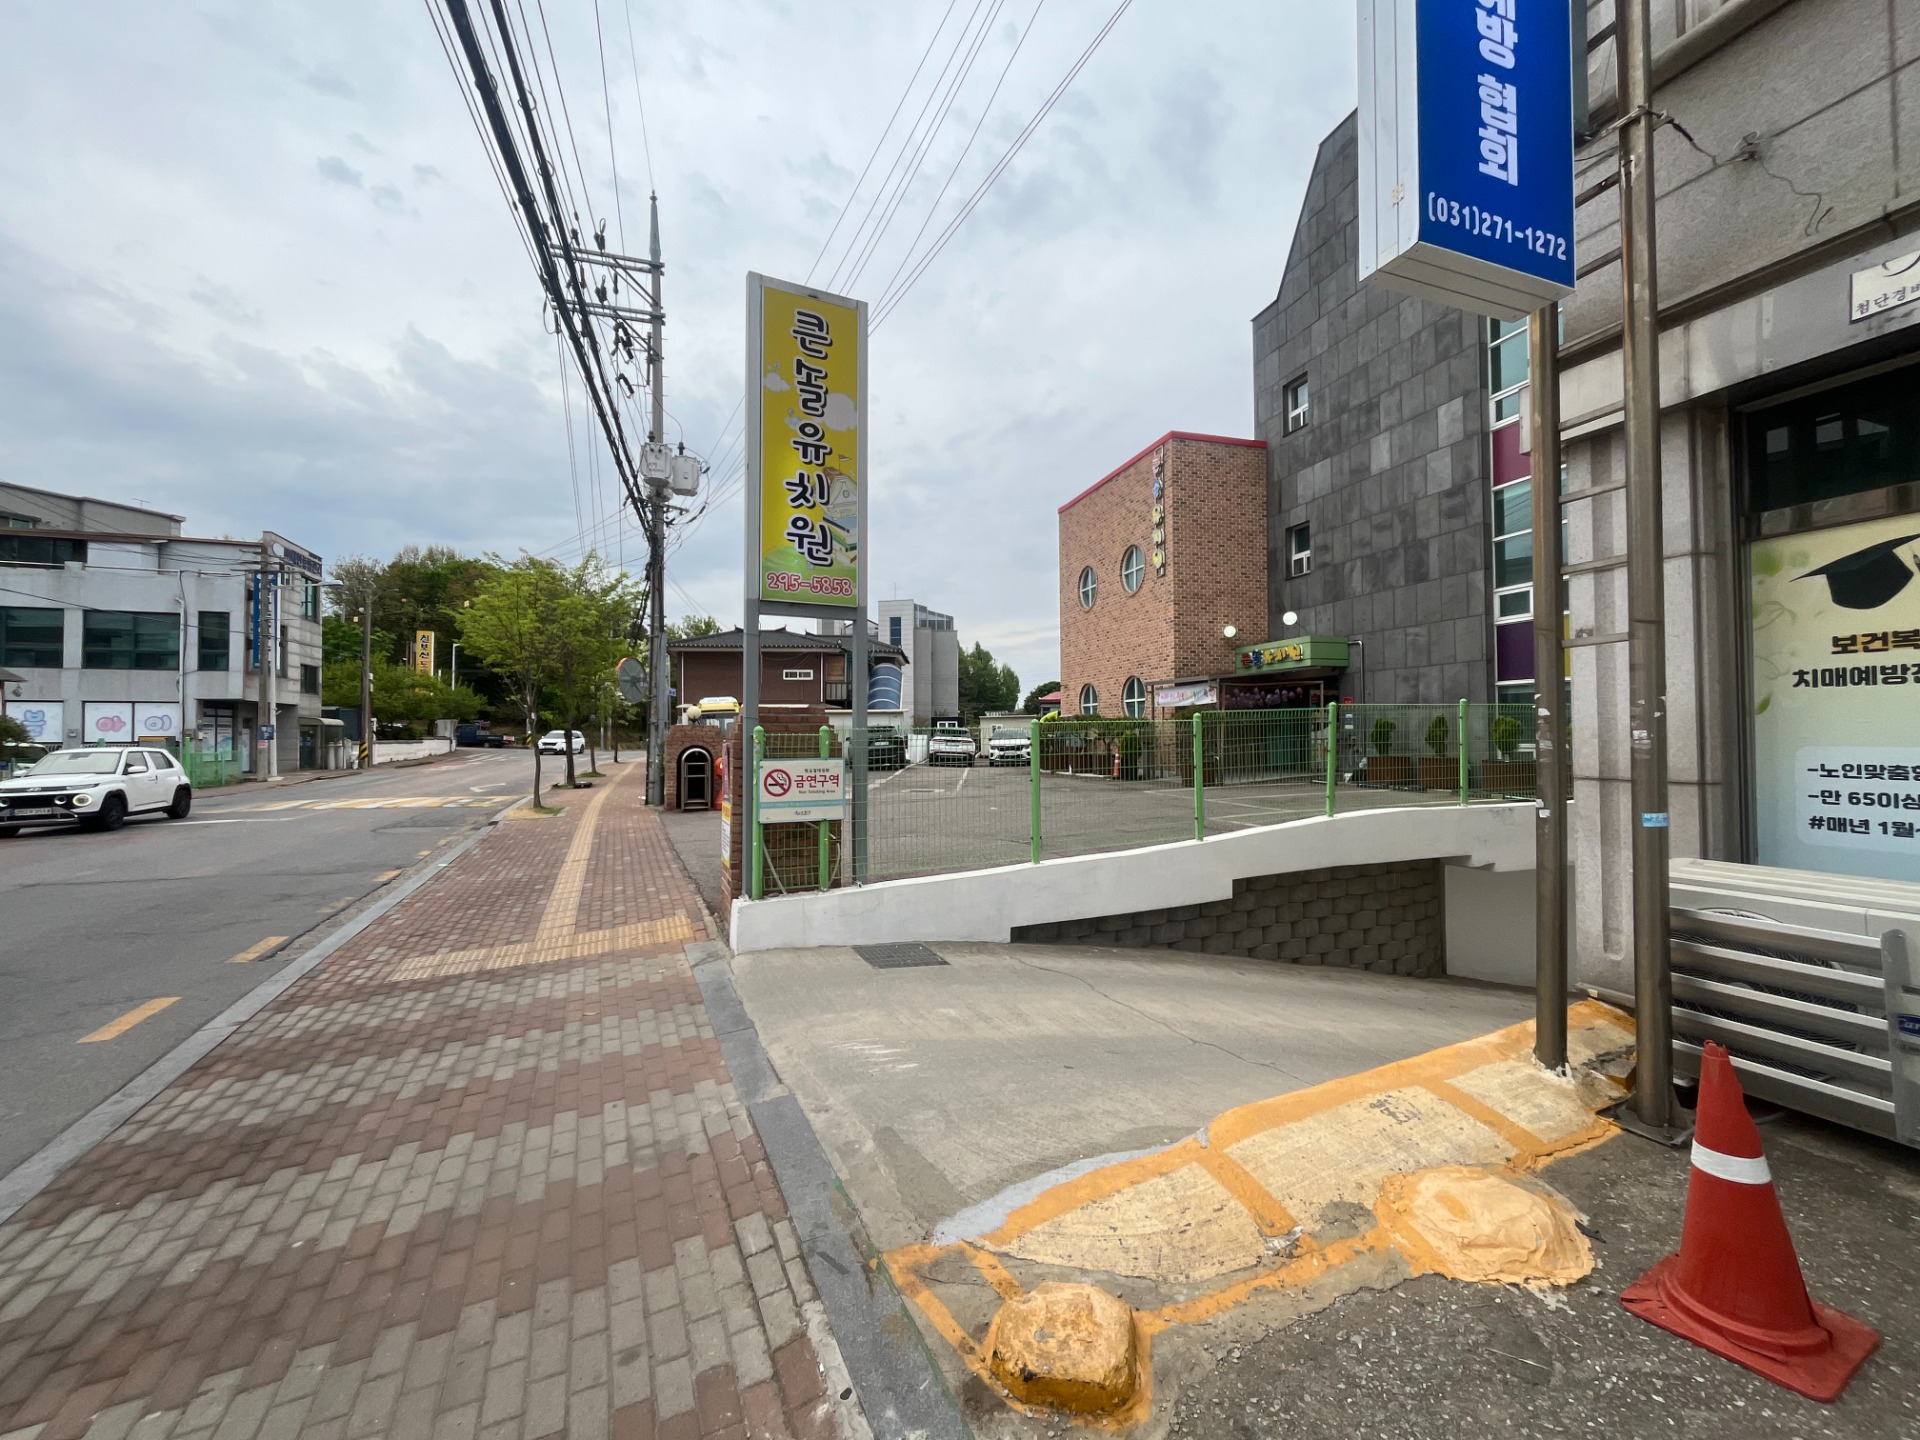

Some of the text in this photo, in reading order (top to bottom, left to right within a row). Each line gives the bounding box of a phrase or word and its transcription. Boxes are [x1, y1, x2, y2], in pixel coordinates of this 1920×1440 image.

[1474, 0, 1519, 69] 방
[1428, 191, 1567, 261] (031)271-1272
[767, 573, 853, 597] 295-5858
[794, 773, 840, 788] 금연구역
[1808, 815, 1870, 835] #매년
